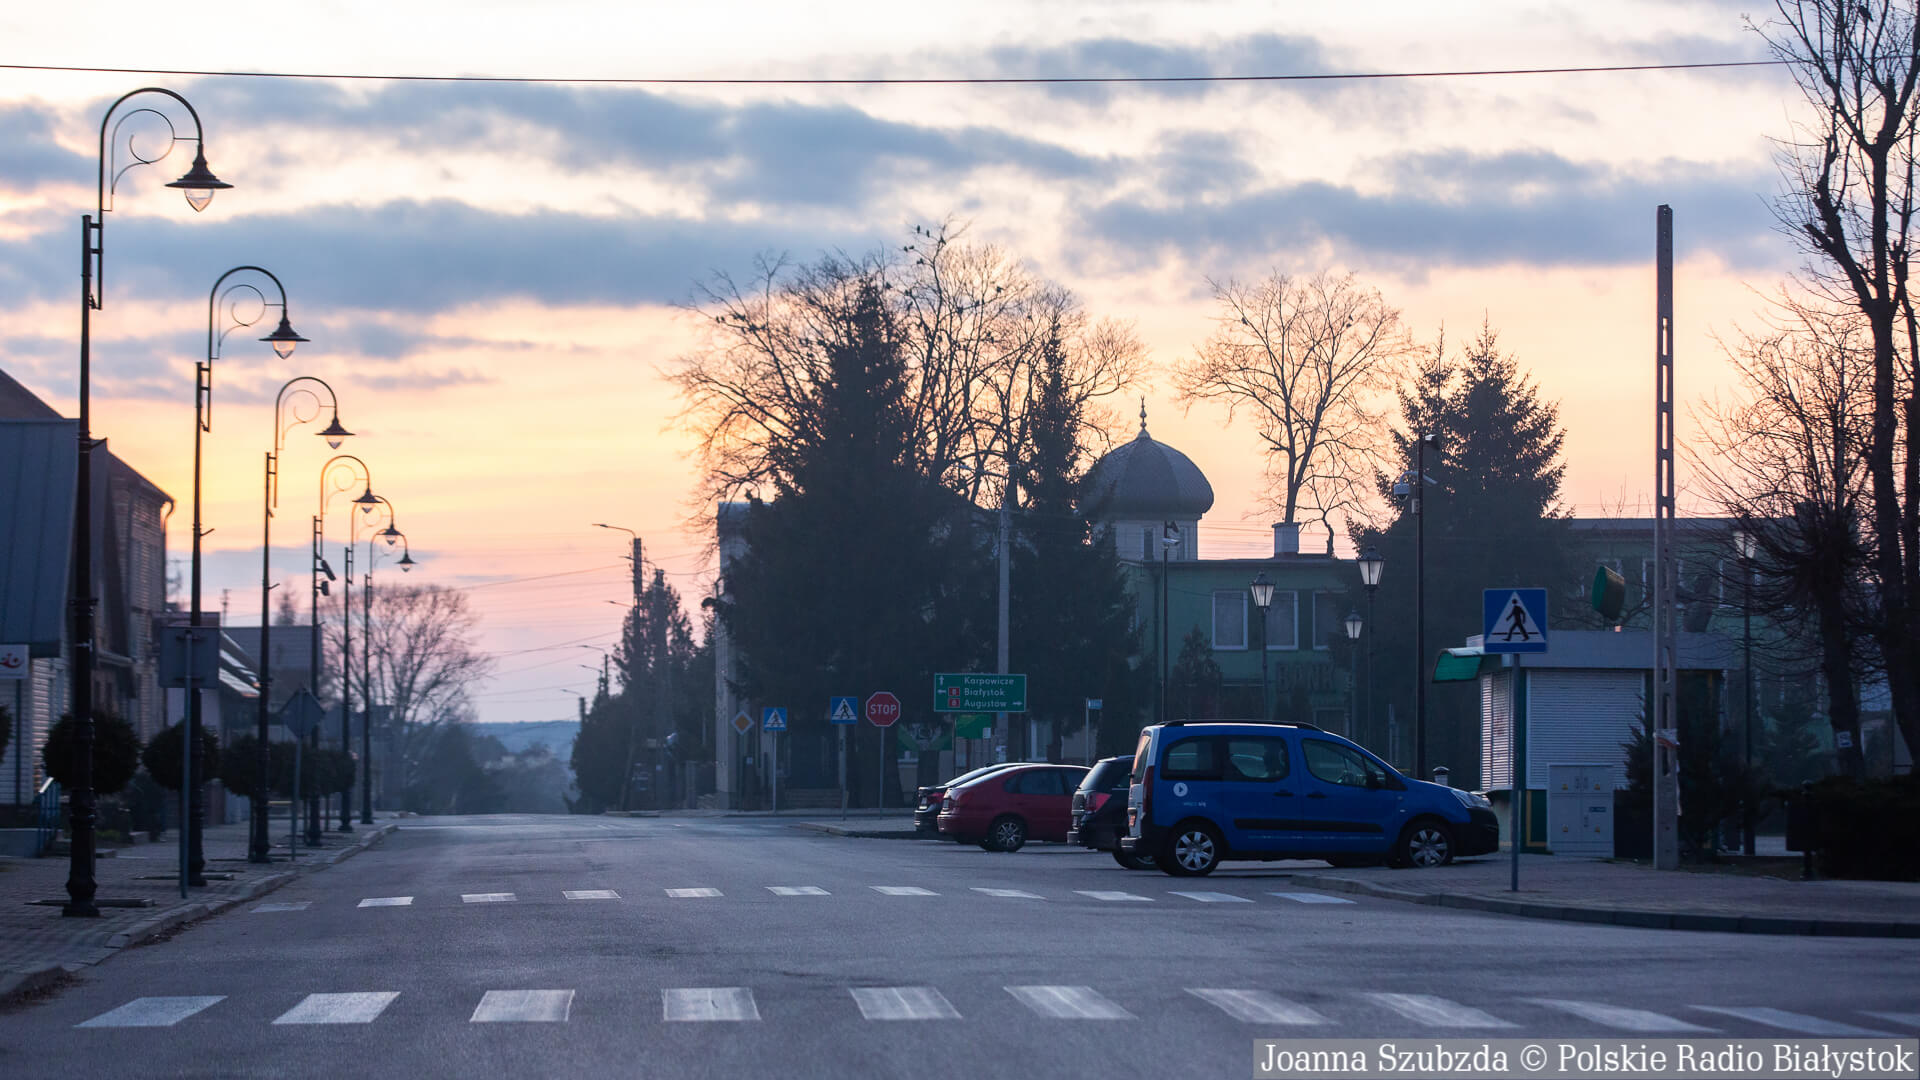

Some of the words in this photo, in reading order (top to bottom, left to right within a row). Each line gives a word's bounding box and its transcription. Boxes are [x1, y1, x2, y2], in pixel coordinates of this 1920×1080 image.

[964, 676, 1014, 686] Karpowicze
[964, 687, 1006, 698] Białystok
[870, 703, 896, 715] STOP
